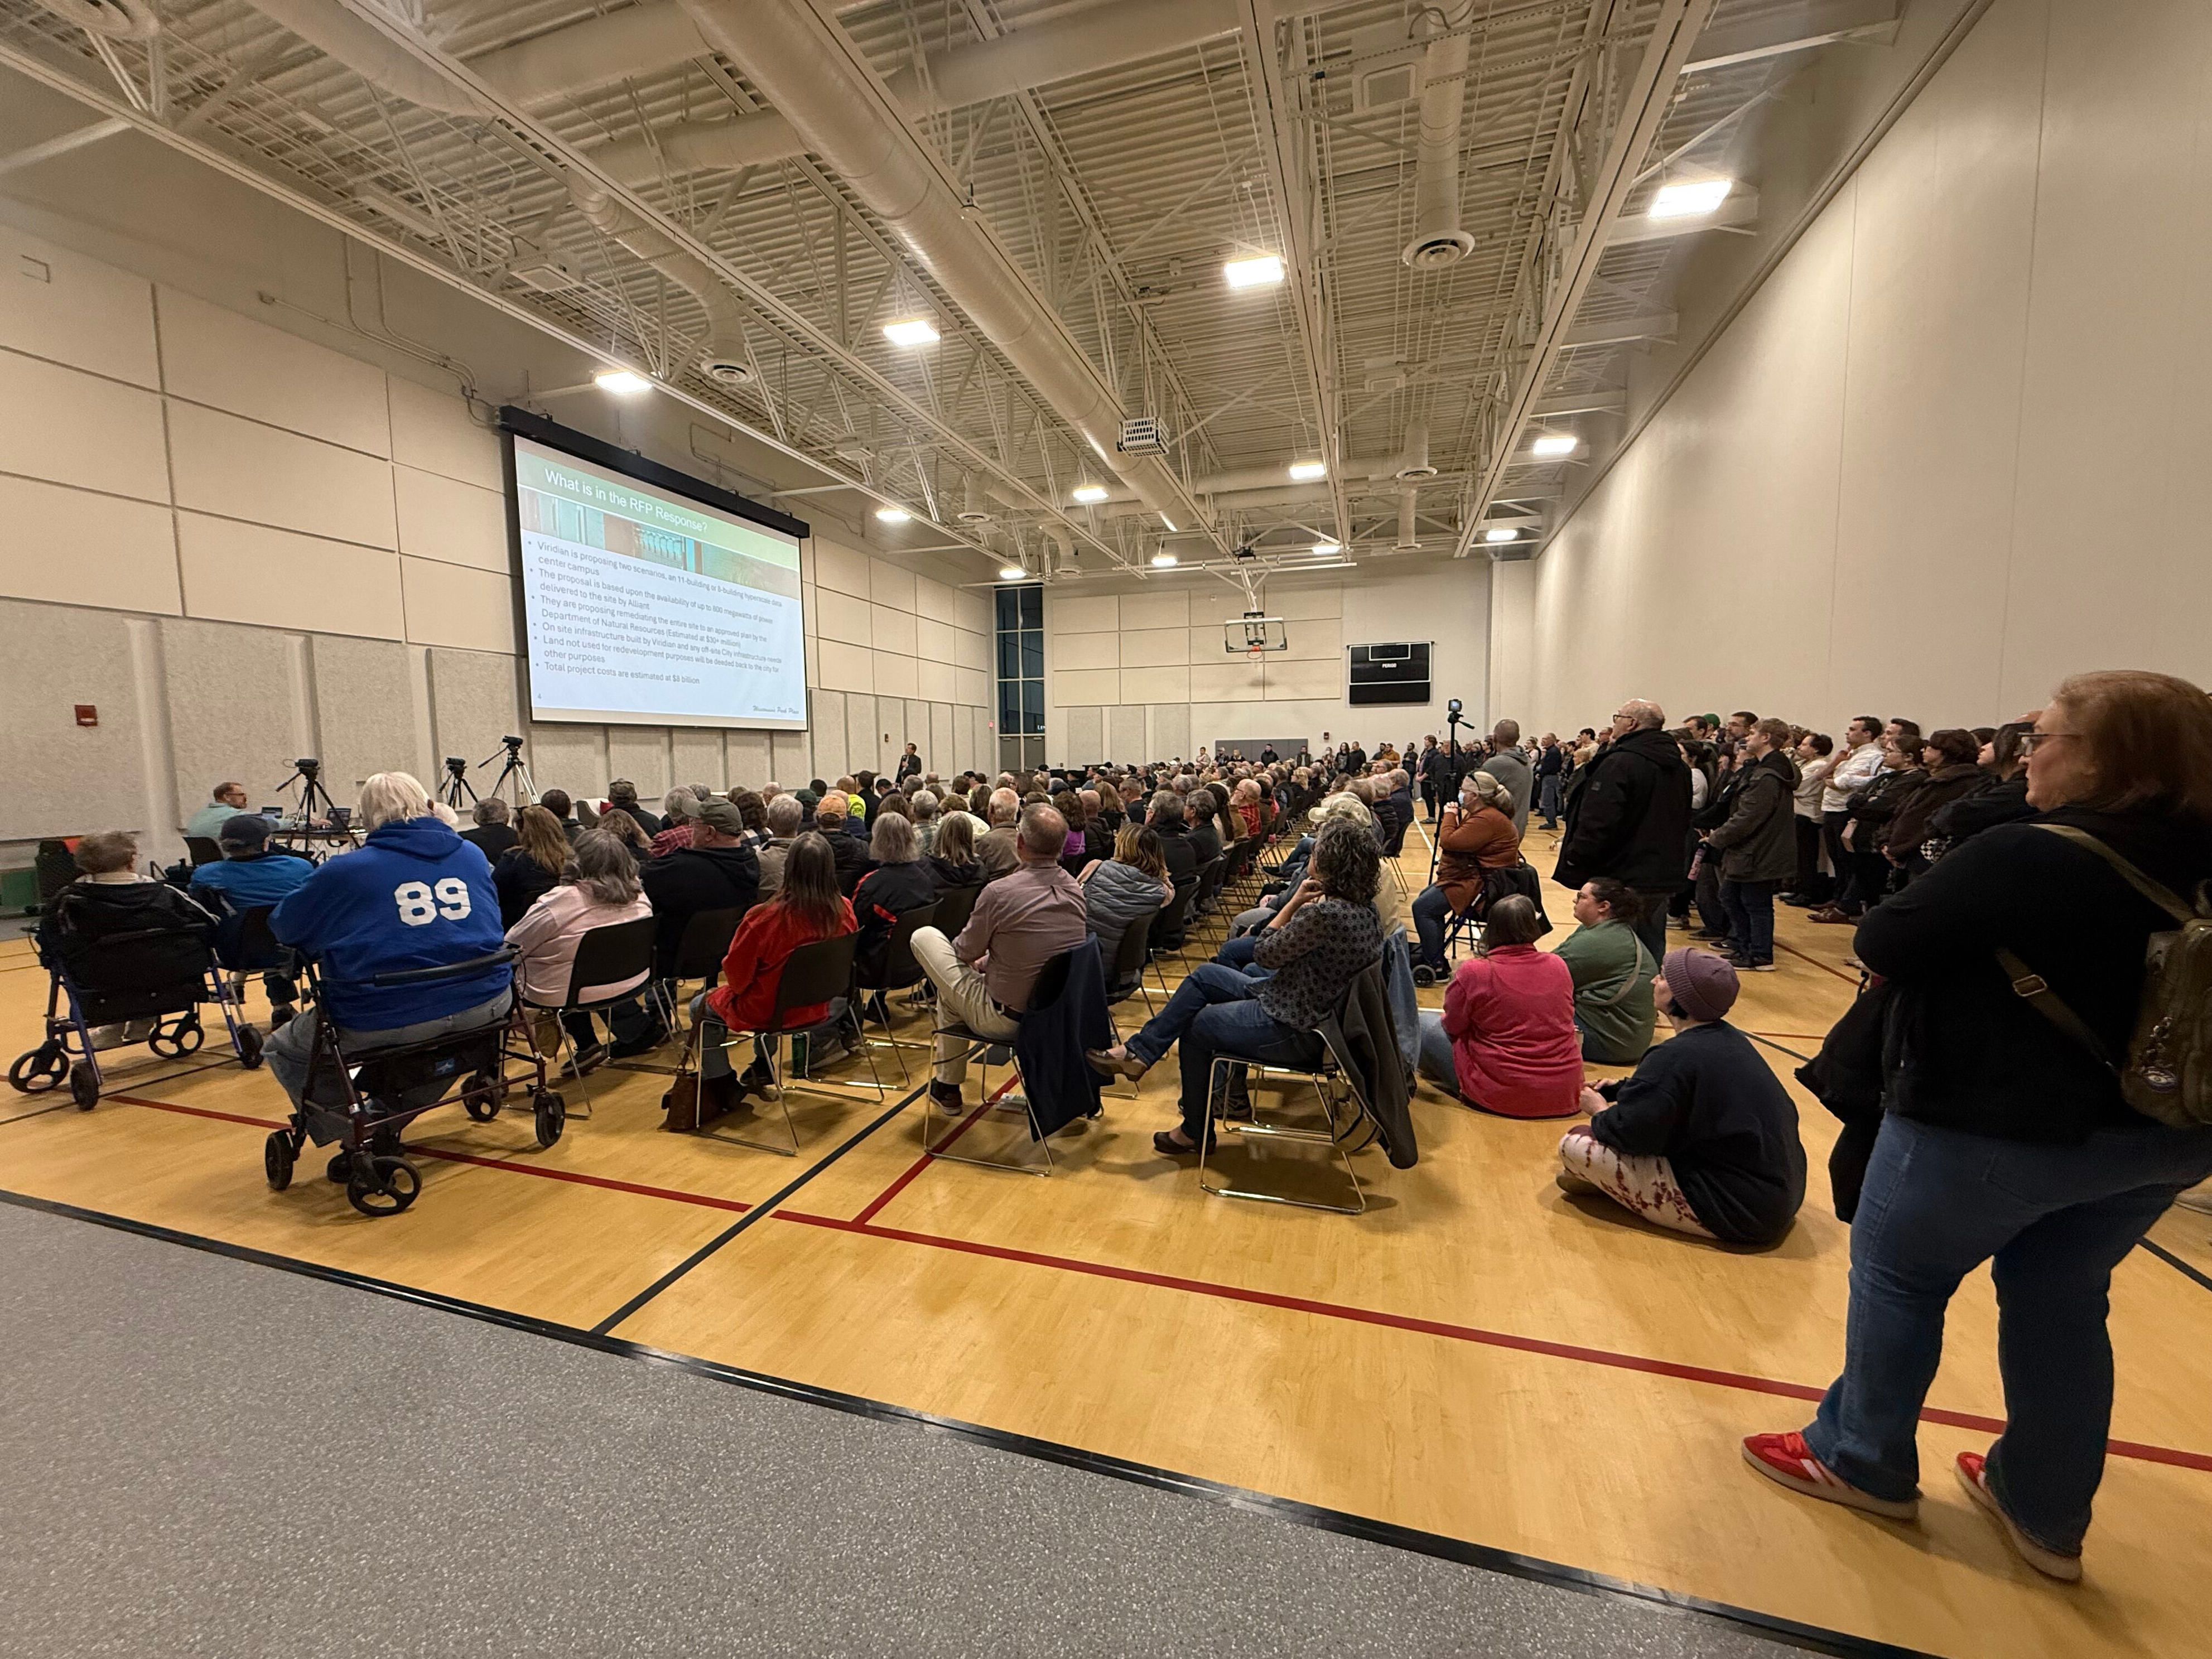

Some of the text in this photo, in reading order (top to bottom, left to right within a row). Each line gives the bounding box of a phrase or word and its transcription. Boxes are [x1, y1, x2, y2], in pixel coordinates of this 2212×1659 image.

[545, 469, 707, 533] What is in the RFP Response?
[537, 542, 569, 556] Viridian
[571, 550, 578, 558] is
[580, 554, 618, 570] proposing
[619, 562, 632, 571] two
[633, 567, 667, 581] scenarios,
[678, 576, 710, 591] 11-building
[538, 557, 599, 576] center campus
[539, 568, 555, 579] The
[558, 574, 592, 587] proposal
[594, 580, 600, 589] is
[602, 582, 624, 593] based
[626, 589, 643, 597] upon
[644, 591, 655, 600] the
[657, 595, 689, 608] availability
[540, 582, 578, 596] delivered
[580, 590, 587, 598] to
[589, 591, 602, 601] the
[618, 597, 627, 607] by
[628, 599, 650, 610] Alliant
[541, 595, 561, 608] They
[579, 604, 615, 617] proposing
[616, 611, 657, 624] remediating
[542, 609, 590, 624] Department
[602, 619, 628, 630] Natural
[630, 624, 664, 635] Resources
[667, 630, 698, 641] (Estimated
[542, 622, 555, 631] On
[557, 625, 572, 634] site
[575, 627, 624, 641] infrastructure
[626, 635, 642, 644] built
[643, 638, 650, 647] by
[652, 639, 676, 648] Viridian
[701, 647, 721, 655] off-site
[543, 636, 564, 645] Land
[613, 646, 664, 658] redevelopment
[544, 649, 605, 663] other purposes
[545, 662, 565, 671] Total
[567, 666, 595, 675] project
[630, 672, 664, 681] estimated
[394, 877, 471, 926] 89
